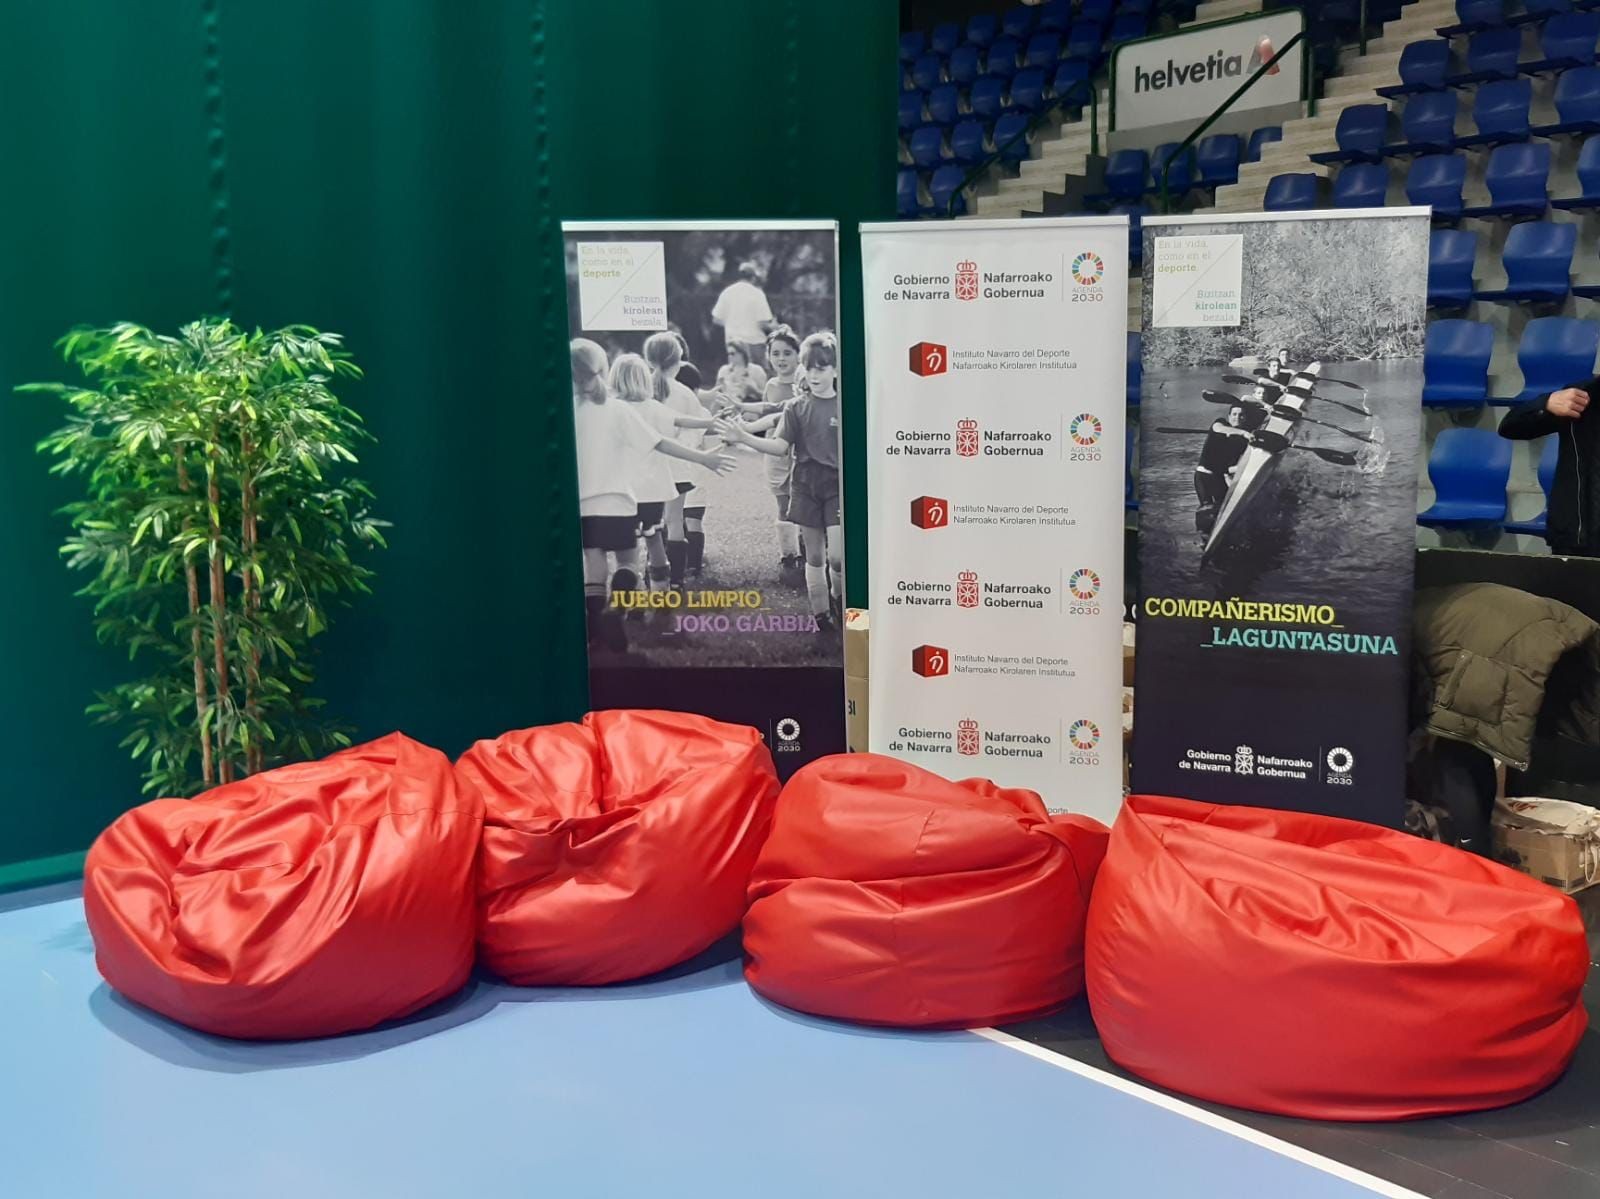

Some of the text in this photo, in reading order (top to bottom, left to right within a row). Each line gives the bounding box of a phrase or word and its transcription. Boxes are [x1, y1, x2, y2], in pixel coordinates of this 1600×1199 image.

[1134, 50, 1242, 93] helvetia
[894, 275, 950, 286] Gobierno
[983, 272, 1053, 283] Nafarroako
[884, 290, 950, 301] de Navarra
[983, 288, 1045, 299] Gobernua
[1072, 294, 1104, 302] 2030
[624, 306, 664, 315] kirolean
[1194, 302, 1237, 310] kirolean
[952, 350, 1070, 359] Instituto Navarro del Deporte
[952, 361, 1077, 370] Nafarroako Kirolaren Institutua
[896, 430, 951, 441] Gobierno
[984, 430, 1052, 441] Nafarroako
[886, 445, 951, 456] de Navarra
[984, 446, 1044, 456] Gobernua
[1070, 453, 1102, 461] 2030
[954, 505, 1069, 516] Instituto Navarro del Deporte
[954, 516, 1076, 526] Nafarroako Kirolaren Institutua
[897, 581, 952, 592] Gobierno
[984, 583, 1051, 595] Nafarroako
[611, 590, 681, 608] JUEGO
[888, 595, 952, 606] de Navarra
[984, 598, 1044, 609] Gobernua
[1069, 607, 1100, 615] 2030
[737, 615, 820, 633] GARBIA
[954, 654, 1069, 667] Instituto Navarro del Deporte
[954, 666, 1076, 677] Nafarroako Kirolaren Institutua
[898, 728, 952, 740] Gobierno
[985, 732, 1051, 745] Nafarroako
[889, 742, 952, 754] de Navarra
[985, 746, 1043, 758] Gobernua
[1187, 749, 1232, 762] Gobierno
[1069, 757, 1100, 766] 2030
[1178, 760, 1232, 773] de Navarra
[1257, 755, 1313, 769] Nafarroako
[1257, 767, 1306, 779] Gobernua
[1327, 777, 1353, 786] 2030
